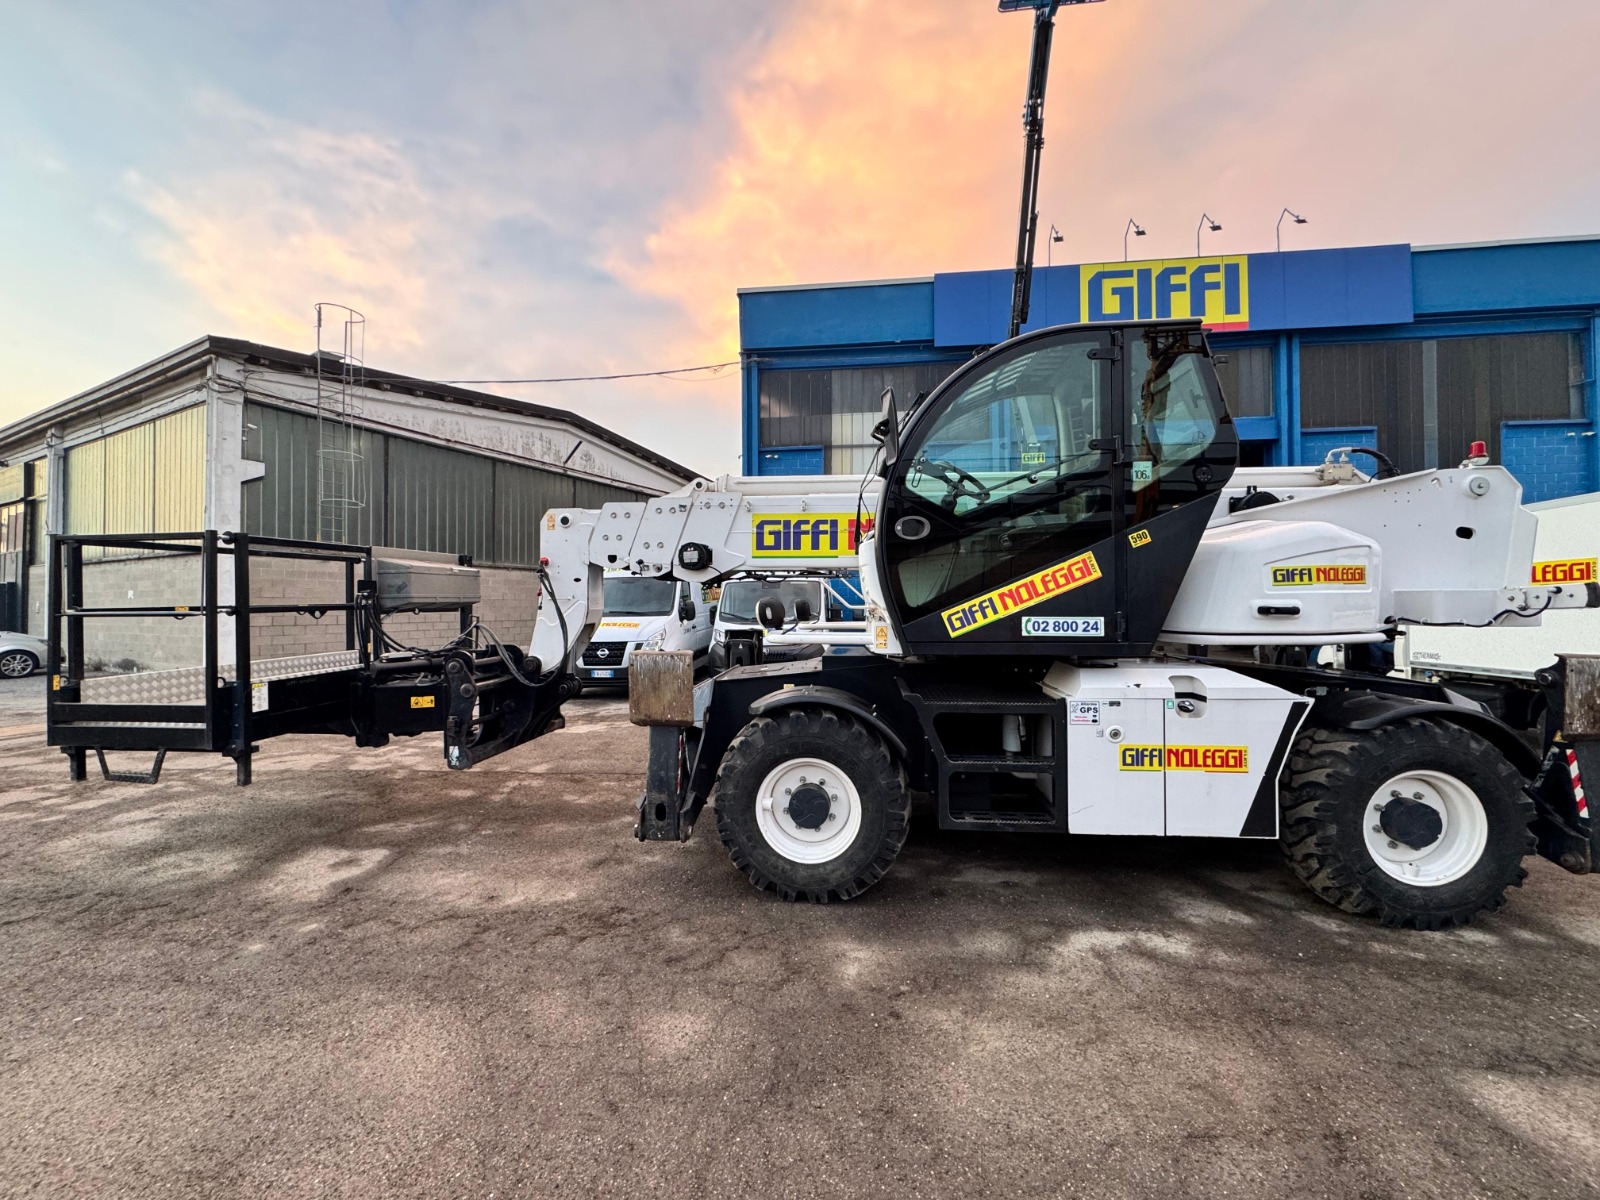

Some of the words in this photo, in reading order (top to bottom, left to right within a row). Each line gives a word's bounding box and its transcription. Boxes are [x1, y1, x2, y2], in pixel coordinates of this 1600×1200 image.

[1087, 262, 1241, 322] GIFFI
[1023, 454, 1044, 462] GIFFI
[1134, 470, 1147, 480] 106
[755, 519, 838, 551] GIFFI
[1130, 531, 1148, 544] 590
[1273, 568, 1313, 583] GIFFI
[1315, 567, 1363, 582] NOLEGGI
[1531, 562, 1591, 583] LEGGI
[946, 596, 999, 632] GIFFI
[998, 557, 1093, 611] NOLEGGI
[1032, 620, 1050, 633] 02
[1052, 620, 1079, 632] 800
[1082, 620, 1099, 632] 24
[1079, 706, 1099, 714] GPS
[1121, 748, 1163, 767] GIFFI
[1166, 748, 1243, 769] NOLEGGI
